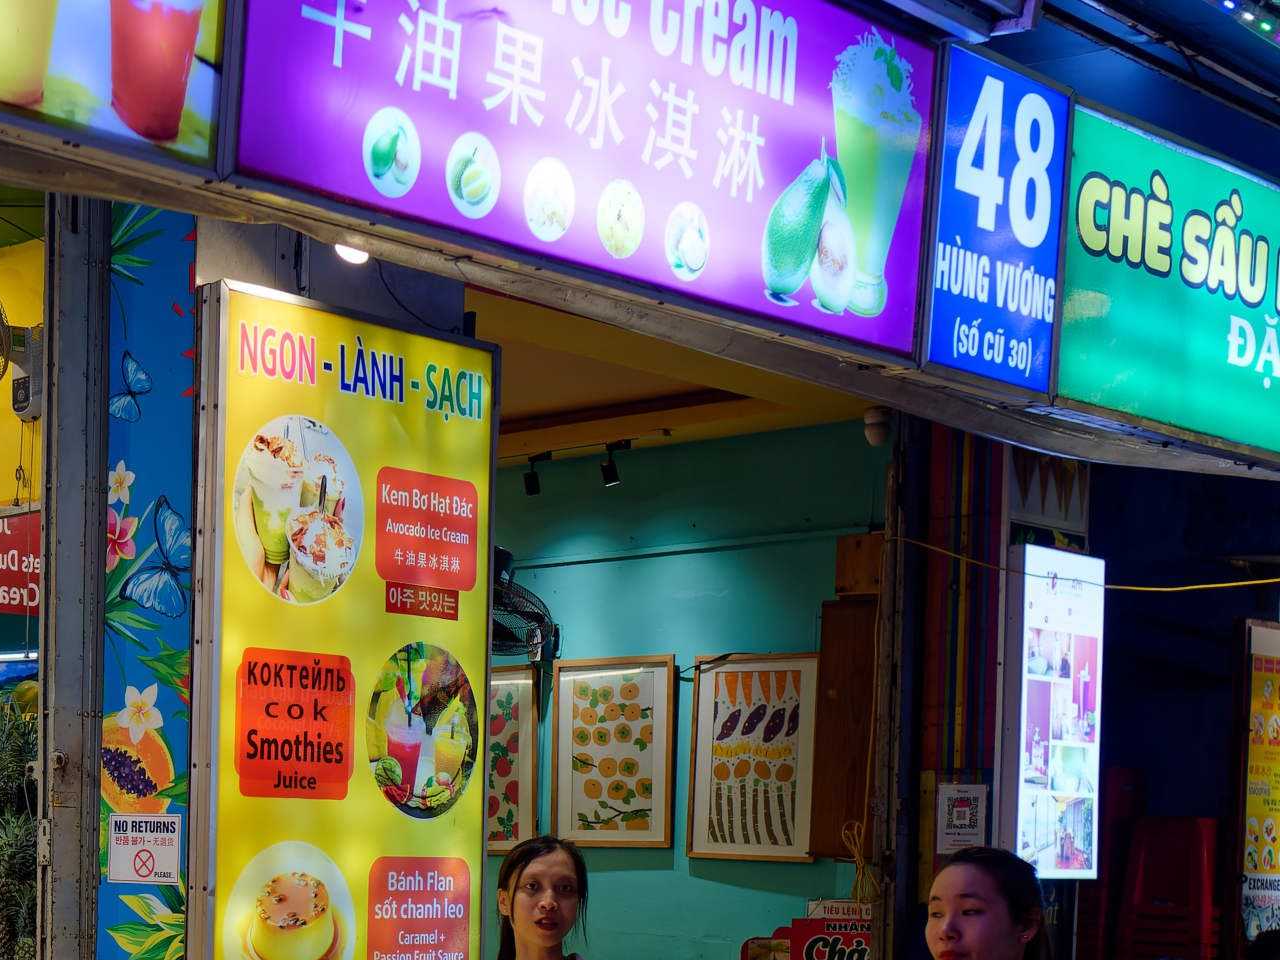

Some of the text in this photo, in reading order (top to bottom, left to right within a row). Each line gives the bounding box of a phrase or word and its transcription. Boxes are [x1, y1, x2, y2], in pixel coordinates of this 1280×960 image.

[955, 75, 1055, 248] 48
[1077, 171, 1269, 304] CHÈ SẦU
[935, 235, 1055, 323] HÙNG VƯƠNG
[1008, 337, 1033, 377] 30)
[239, 321, 316, 385] NGON
[339, 336, 405, 403] LÀNH
[425, 363, 483, 422] SẠCH
[381, 484, 473, 519] Kem Bơ Hạt Đác
[385, 518, 470, 545] Avocado Ice Cream
[393, 548, 461, 573] 牛油果冰淇淋
[389, 587, 456, 614] 아주 맛있는
[246, 728, 345, 765] Smothies
[273, 771, 318, 791] Juice
[113, 820, 176, 834] NO RETURNS
[387, 870, 454, 892] Bánh Flan
[374, 897, 464, 920] sốt chanh leo
[398, 930, 438, 946] Caramel
[825, 921, 871, 933] NHẬN
